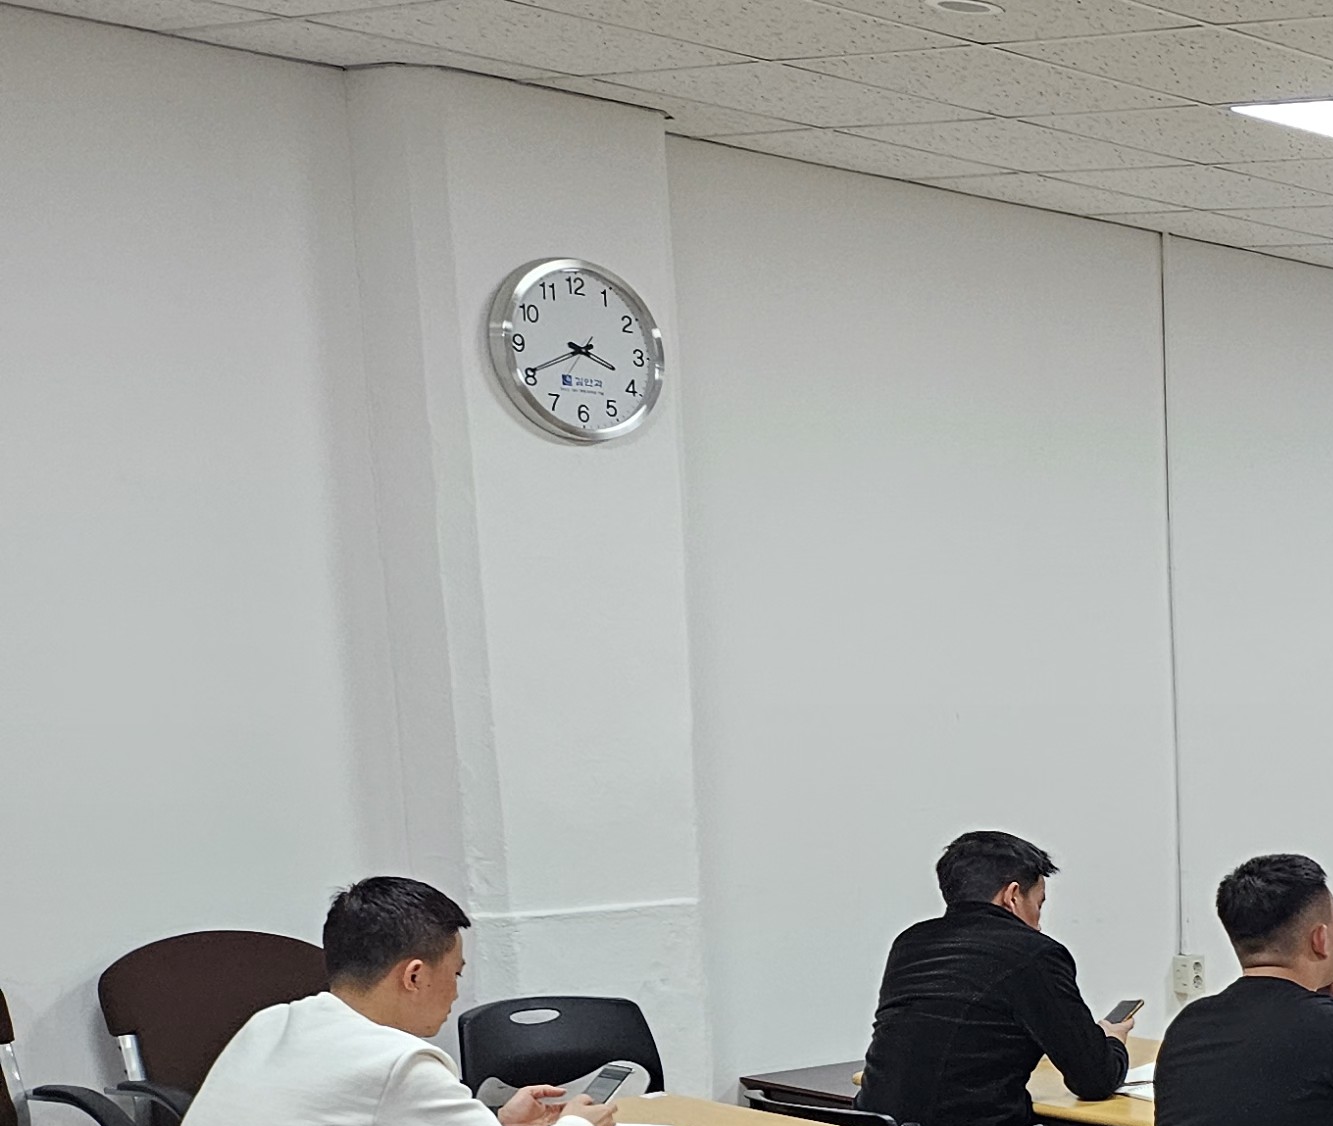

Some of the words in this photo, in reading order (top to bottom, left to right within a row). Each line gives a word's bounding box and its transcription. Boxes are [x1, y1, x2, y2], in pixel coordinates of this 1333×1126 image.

[540, 282, 556, 301] 11
[566, 276, 586, 297] 12
[600, 289, 607, 307] 1
[519, 303, 539, 323] 10
[621, 315, 633, 334] 2
[512, 333, 525, 352] 9
[632, 349, 645, 367] 3
[524, 367, 537, 386] 8
[625, 379, 637, 397] 4
[548, 393, 560, 411] 7
[606, 400, 617, 417] 5
[577, 404, 590, 423] 6
